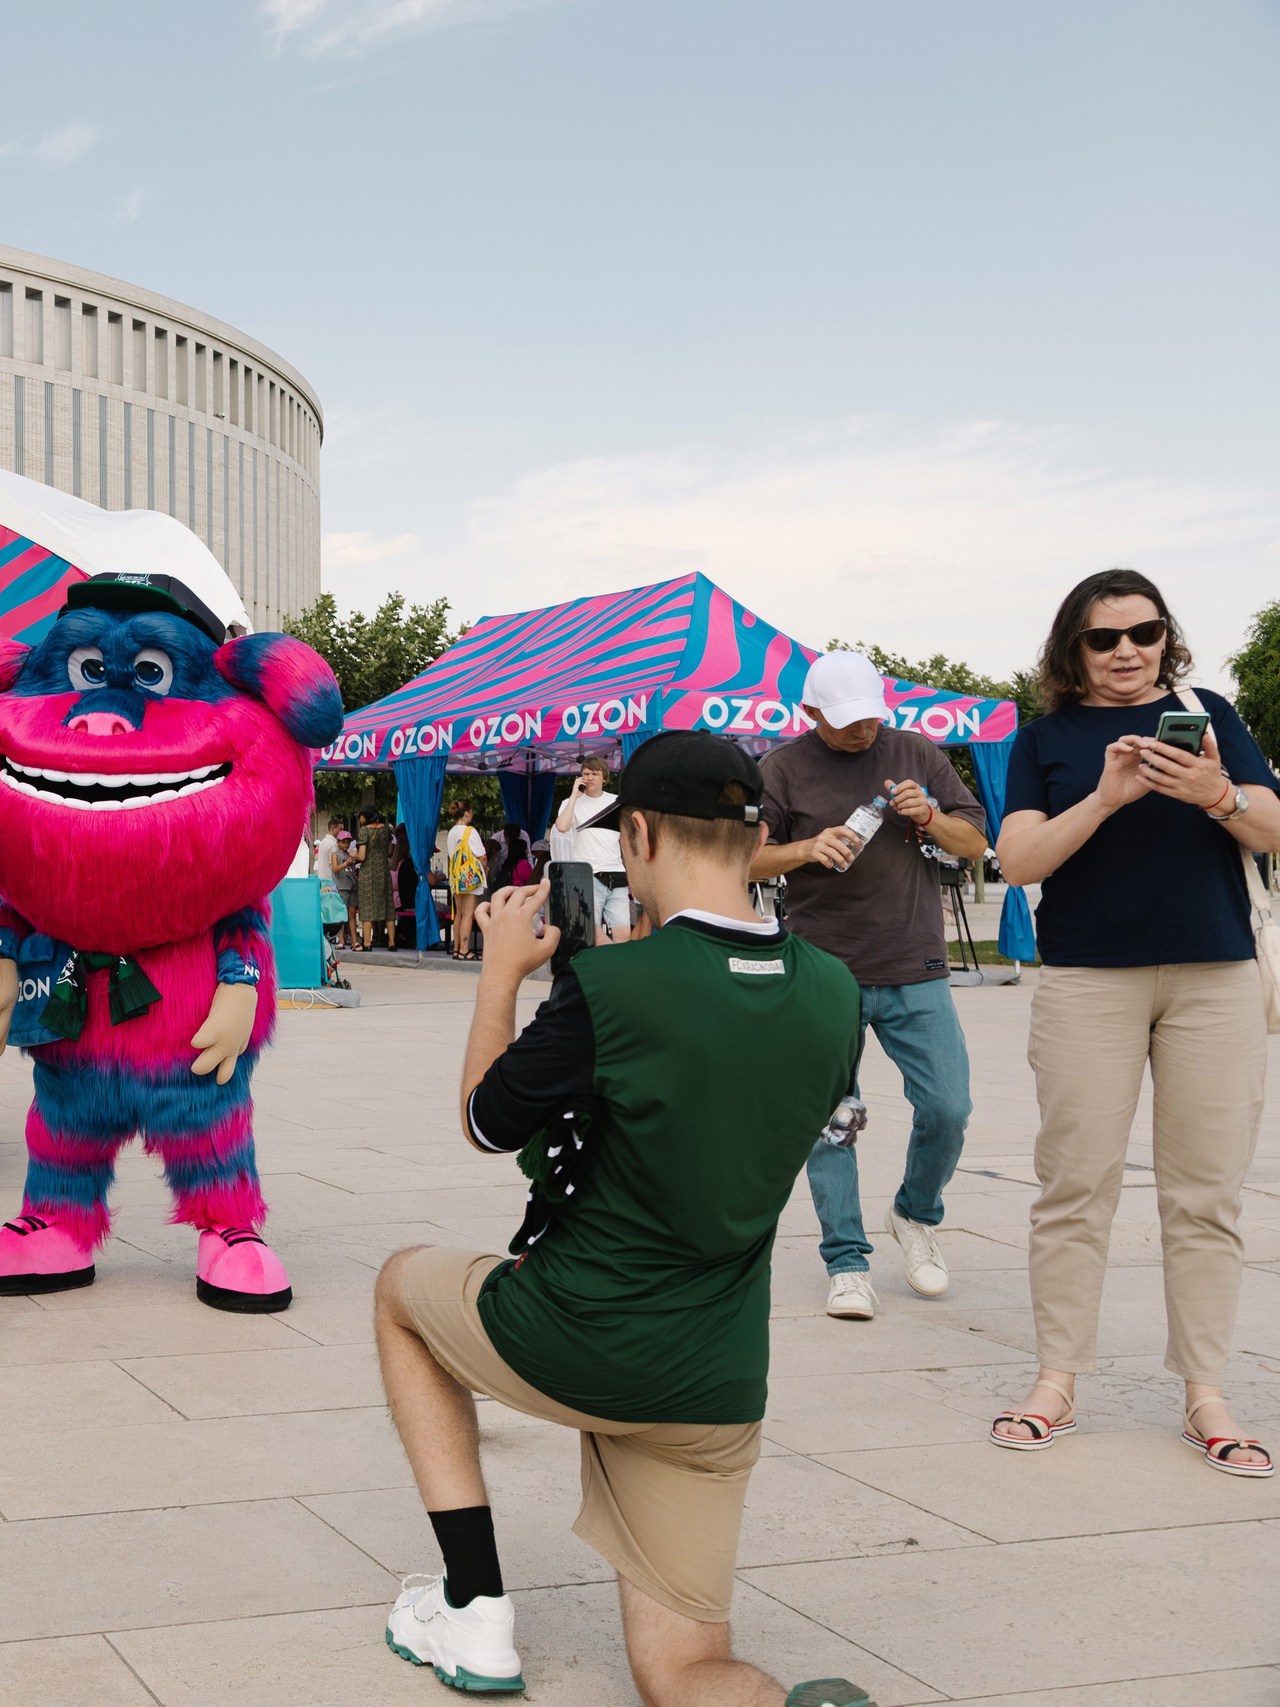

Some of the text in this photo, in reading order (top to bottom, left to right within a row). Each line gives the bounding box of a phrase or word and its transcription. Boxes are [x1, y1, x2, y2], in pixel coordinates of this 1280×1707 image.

[391, 723, 453, 753] OZON
[470, 710, 542, 747] OZON
[562, 695, 647, 735] OZON
[18, 976, 51, 1003] ZON
